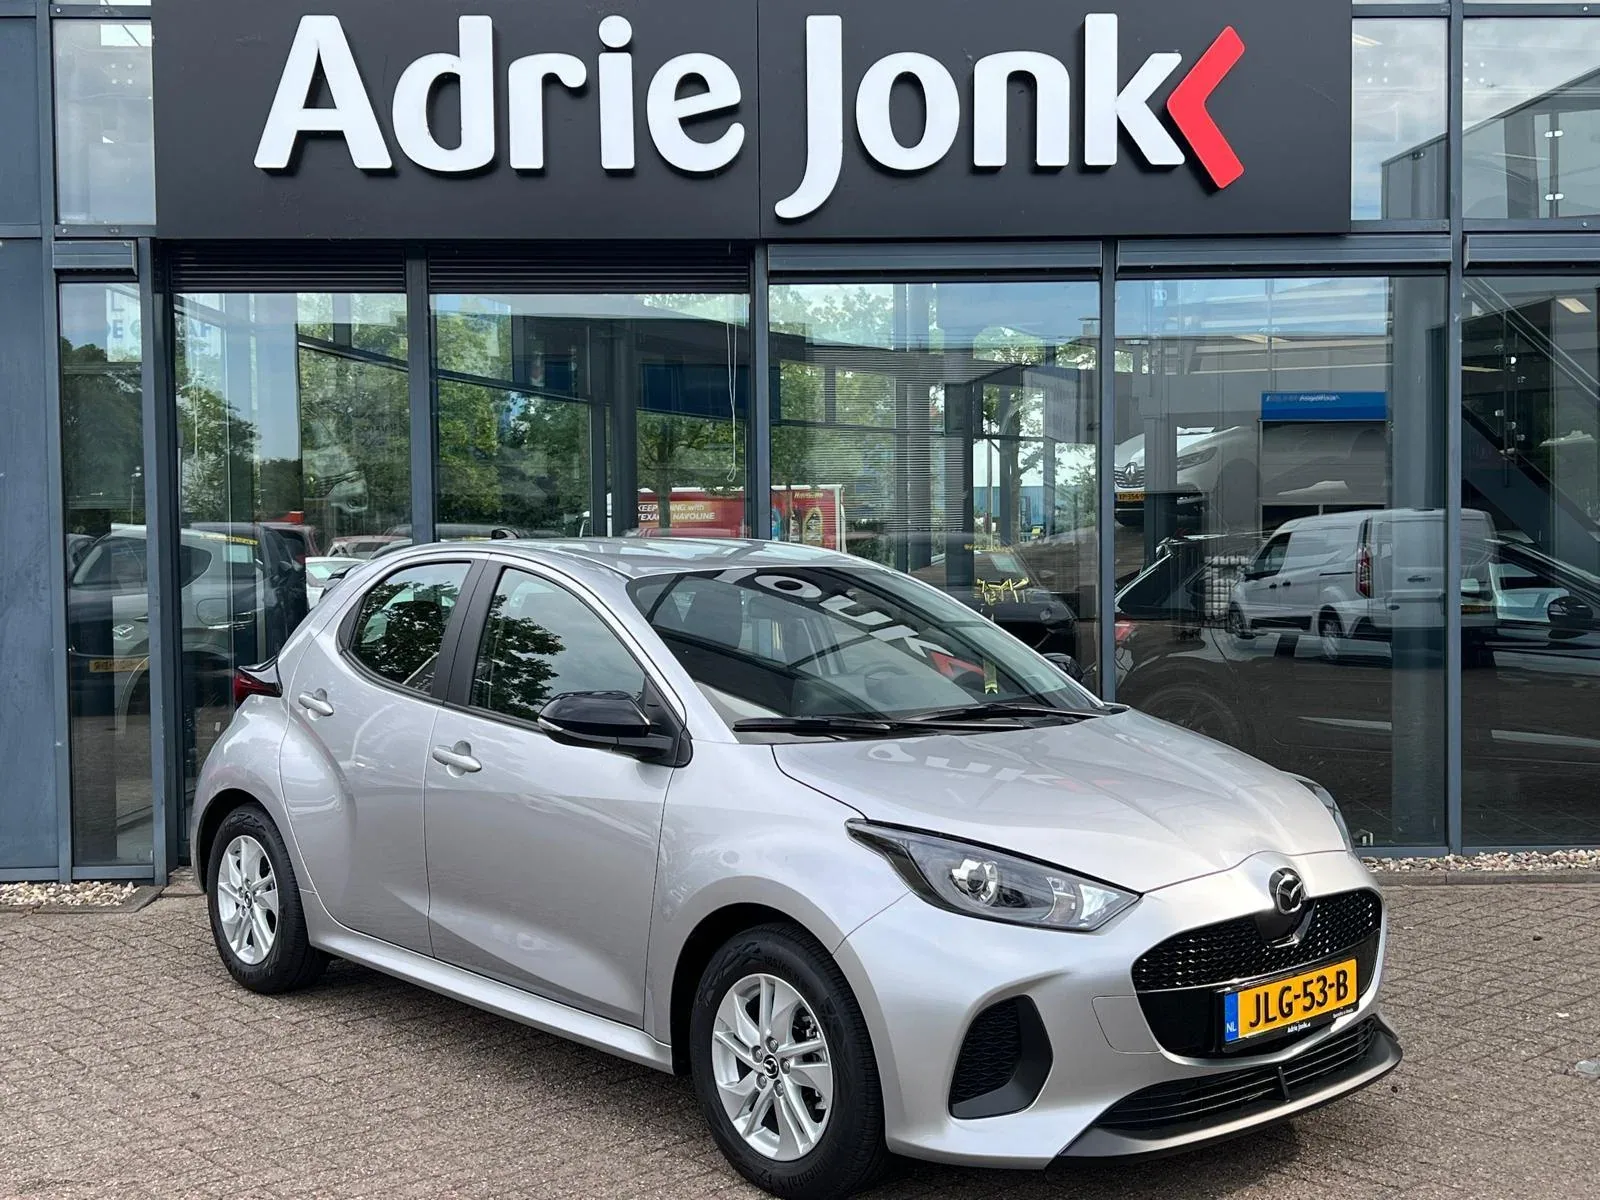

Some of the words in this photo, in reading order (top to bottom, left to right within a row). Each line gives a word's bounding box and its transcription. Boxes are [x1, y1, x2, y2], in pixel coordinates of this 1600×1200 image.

[253, 14, 746, 173] Adrie
[774, 12, 1187, 219] Jonk
[1226, 1021, 1238, 1034] NL
[1249, 969, 1349, 1028] JLG-53-B
